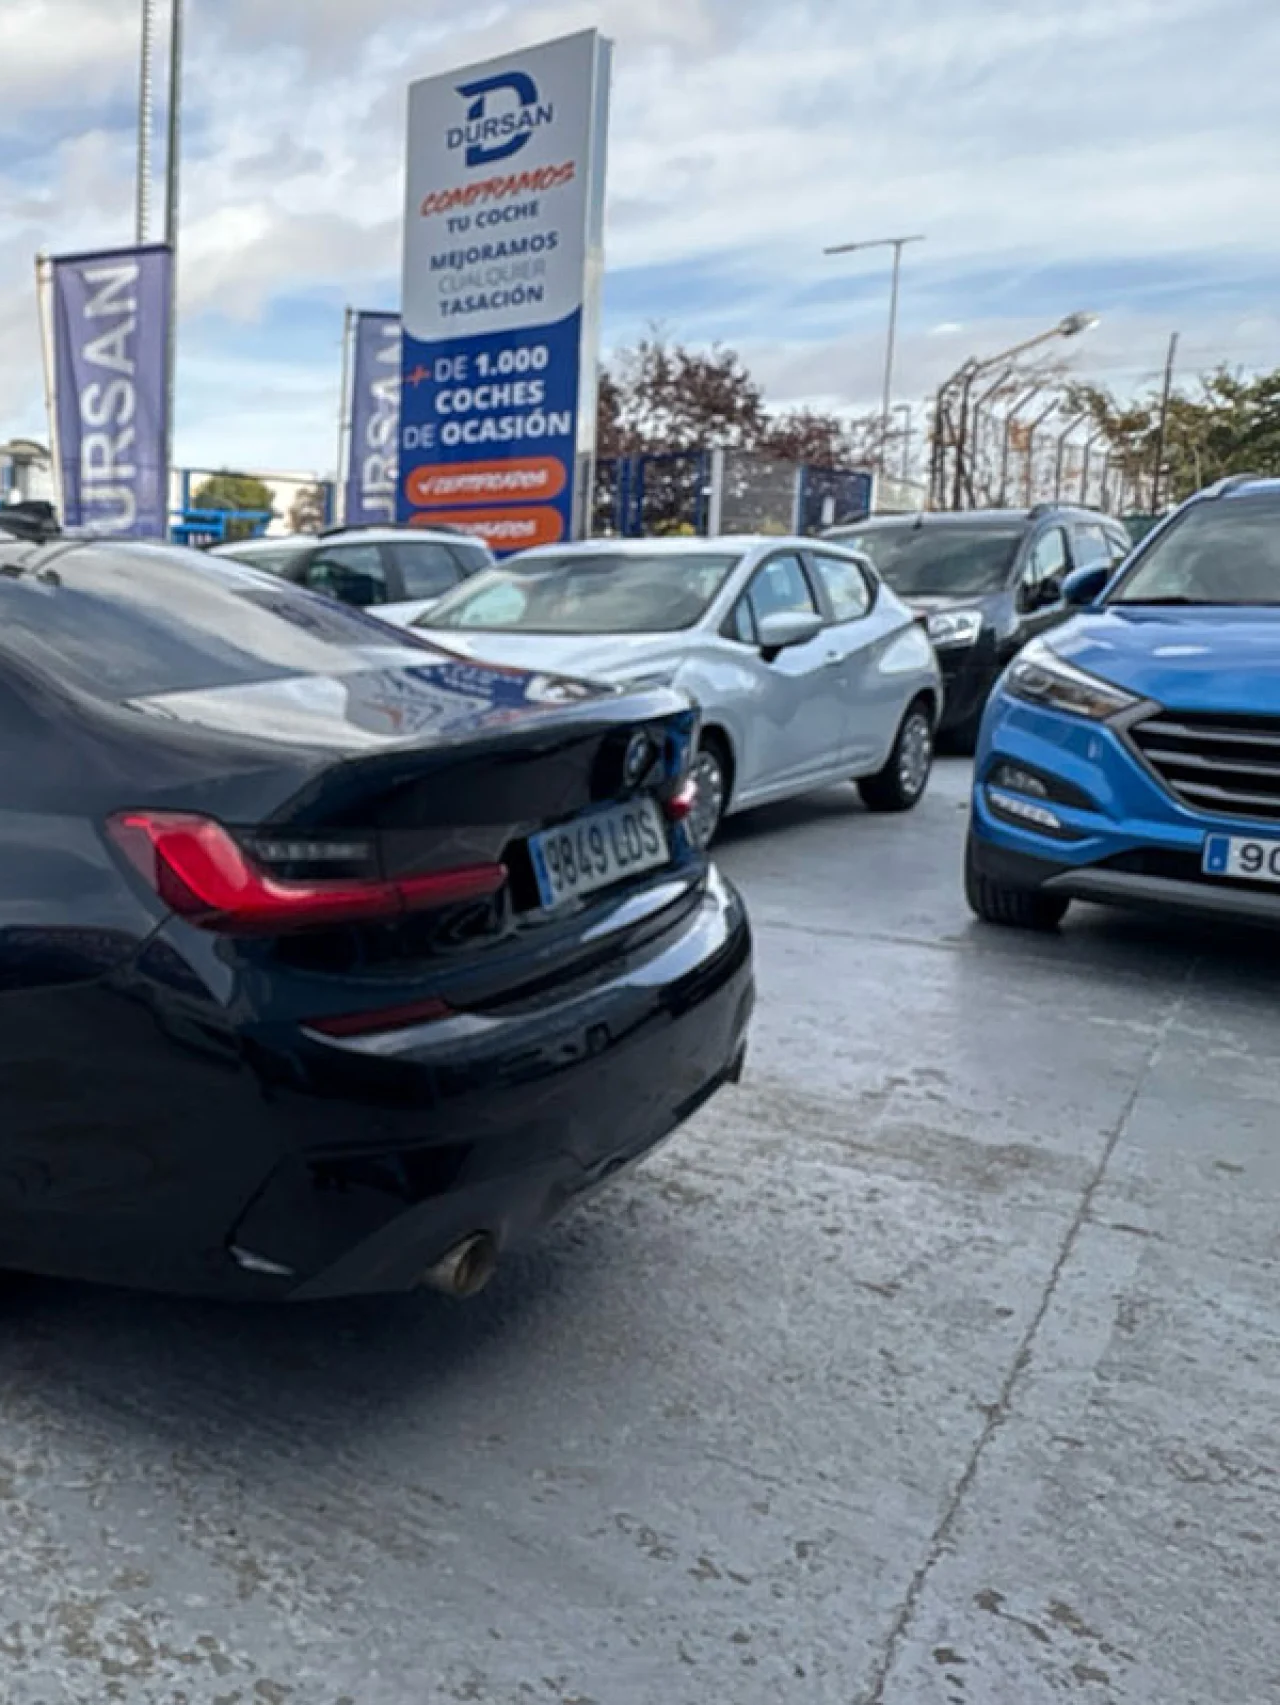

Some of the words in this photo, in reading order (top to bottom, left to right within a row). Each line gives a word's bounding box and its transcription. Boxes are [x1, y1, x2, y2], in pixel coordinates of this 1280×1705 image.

[446, 103, 554, 149] DURSAN
[419, 159, 576, 217] COMPRAMOS
[447, 216, 469, 234] TU
[475, 200, 540, 229] COCHE
[429, 231, 559, 271] MEJORAMOS
[438, 258, 547, 294] CUALQUIER
[439, 283, 544, 316] TASACIÓN
[434, 356, 468, 382] DE
[475, 345, 549, 377] 1.000
[434, 380, 545, 414] COCHES
[403, 424, 436, 449] DE
[441, 408, 571, 446] OCASIÓN
[546, 824, 608, 891] 9849
[608, 809, 660, 867] LDS
